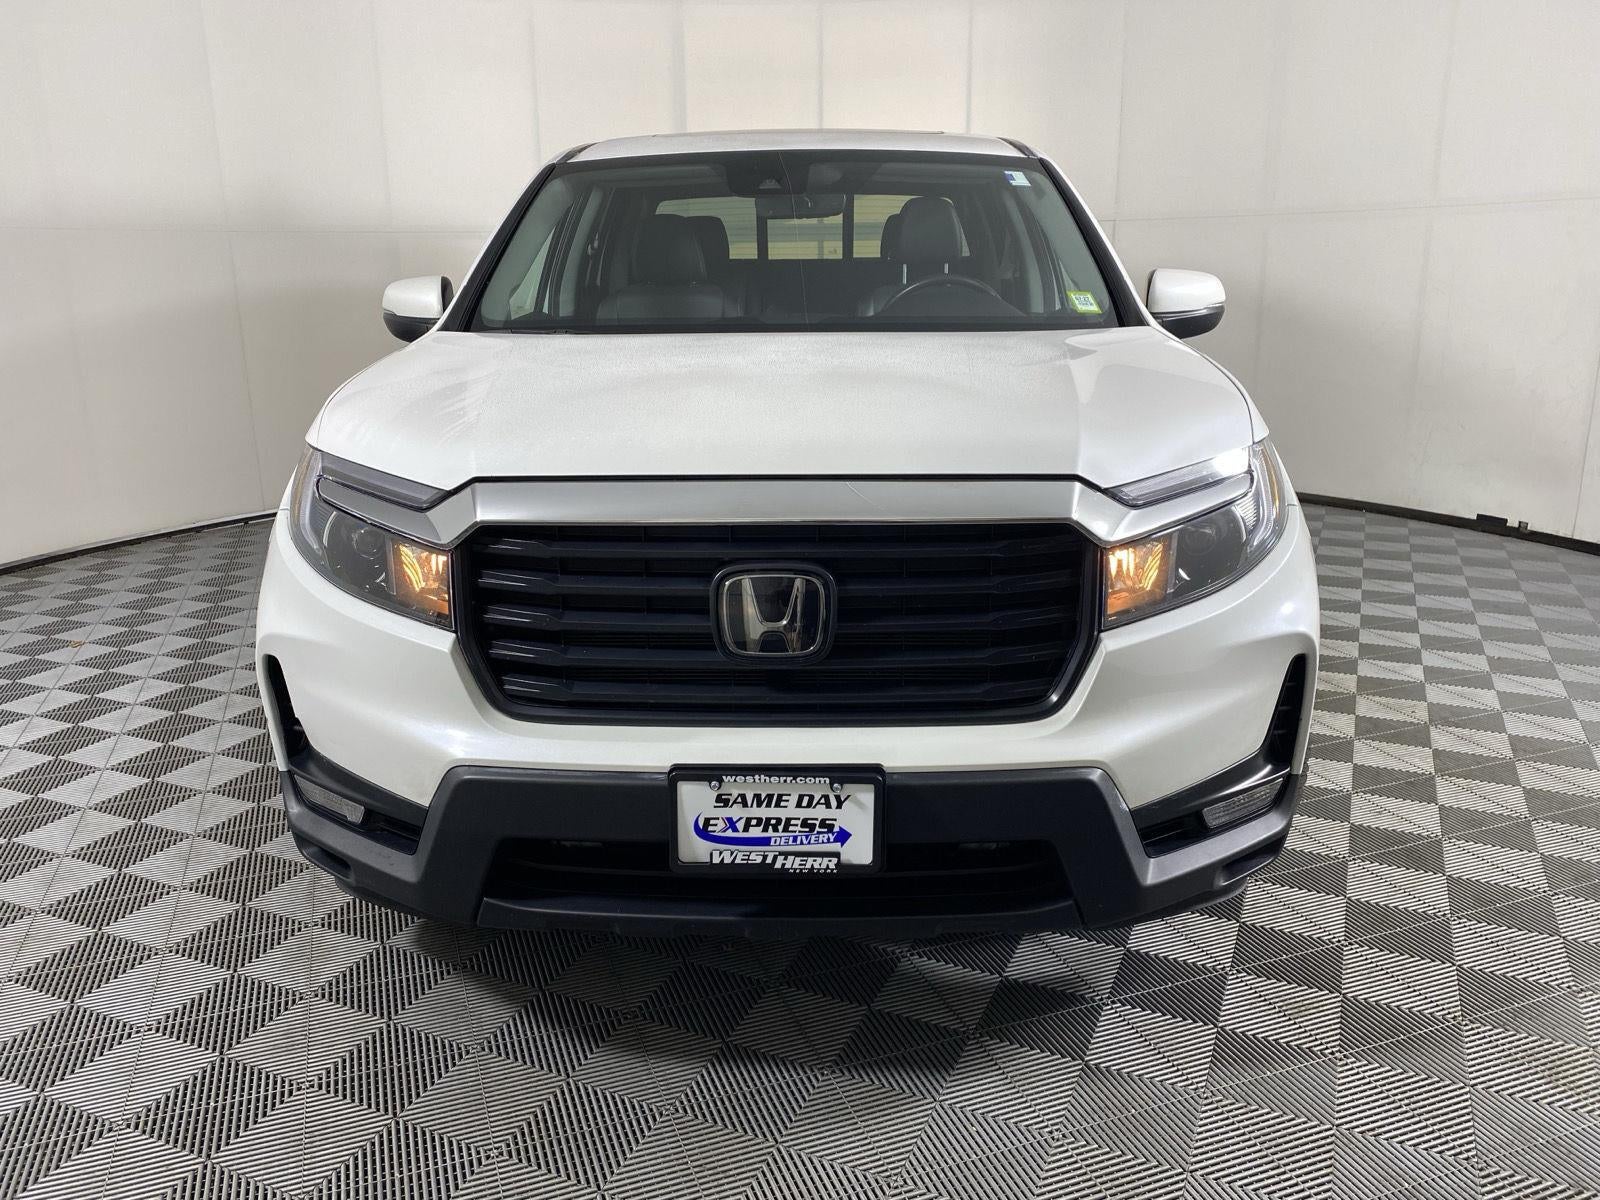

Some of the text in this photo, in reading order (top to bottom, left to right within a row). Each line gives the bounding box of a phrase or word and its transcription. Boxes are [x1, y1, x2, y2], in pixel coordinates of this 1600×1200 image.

[722, 774, 830, 785] westherr.com
[713, 793, 852, 810] SAME DAY
[701, 816, 838, 834] EXPRESS
[770, 833, 838, 847] DELIVERY
